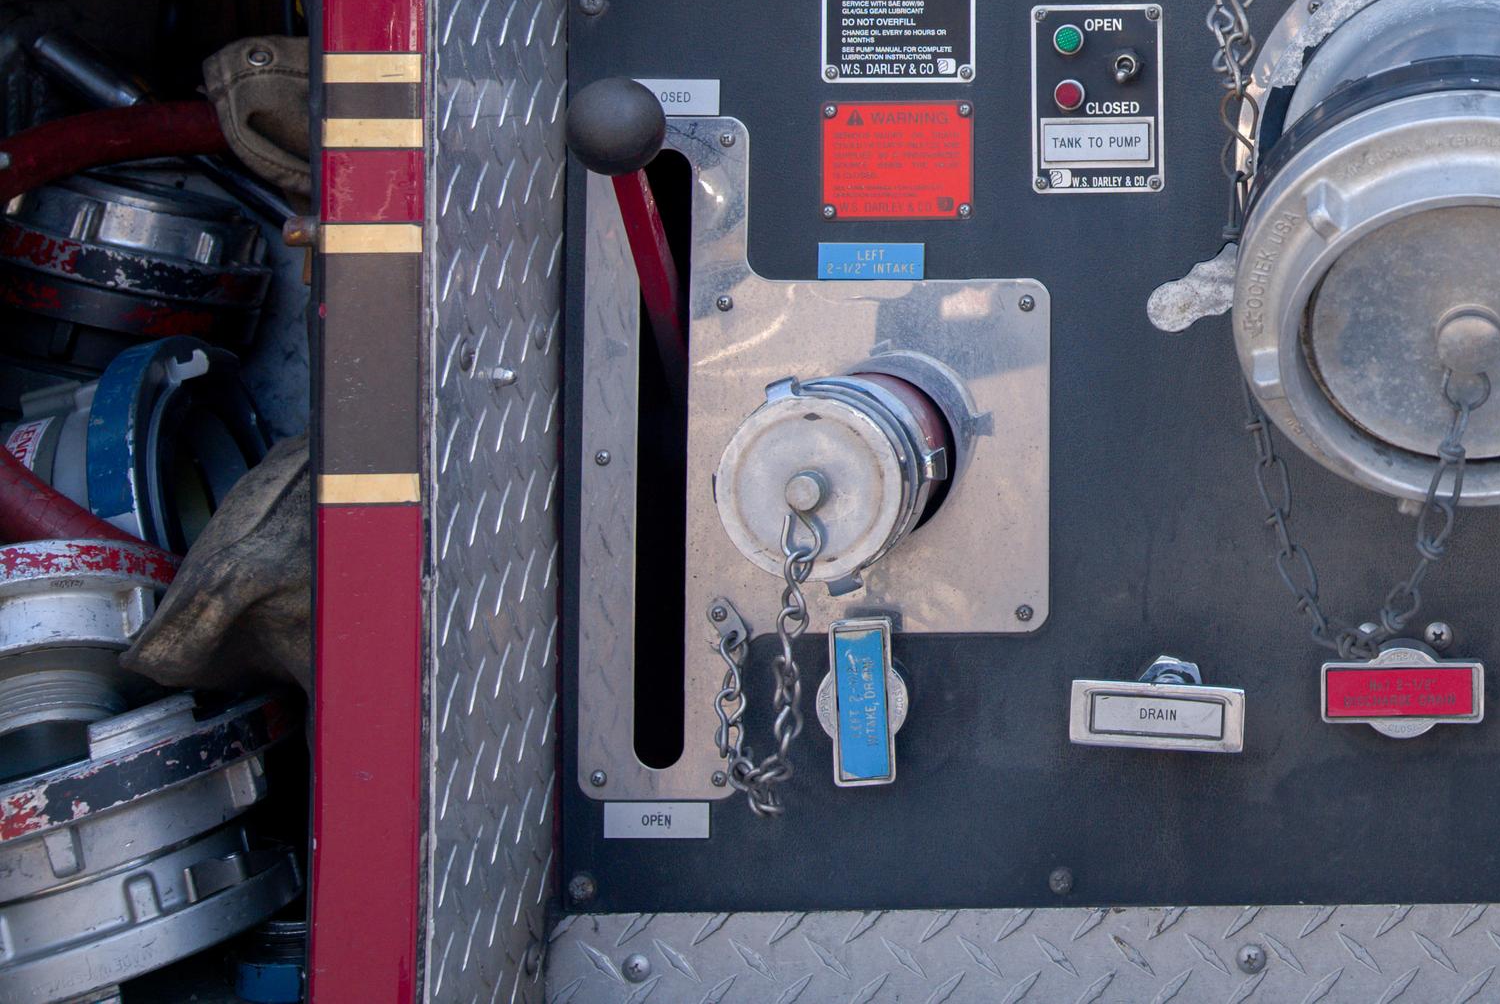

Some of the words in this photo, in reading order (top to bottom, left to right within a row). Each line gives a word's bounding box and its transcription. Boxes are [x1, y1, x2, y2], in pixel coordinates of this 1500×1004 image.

[1084, 18, 1123, 31] OPEN
[841, 64, 863, 75] W.S.
[866, 64, 906, 75] DARLEY
[908, 64, 917, 75] &
[919, 64, 934, 74] CO
[1085, 101, 1139, 115] CLOSED
[870, 111, 949, 125] WARNING
[1052, 137, 1082, 148] TANK
[1088, 137, 1103, 148] TO
[1109, 136, 1141, 148] PUMP
[1072, 177, 1090, 187] W.S.
[1092, 176, 1123, 187] DARLEY
[1125, 176, 1132, 187] &
[1134, 176, 1147, 187] CO.
[1270, 211, 1301, 245] USA
[857, 249, 885, 260] LEFT
[826, 263, 867, 274] 2-1/2"
[873, 263, 915, 274] INTAKE
[1139, 708, 1177, 721] DRAIN
[641, 814, 672, 827] OPEN
